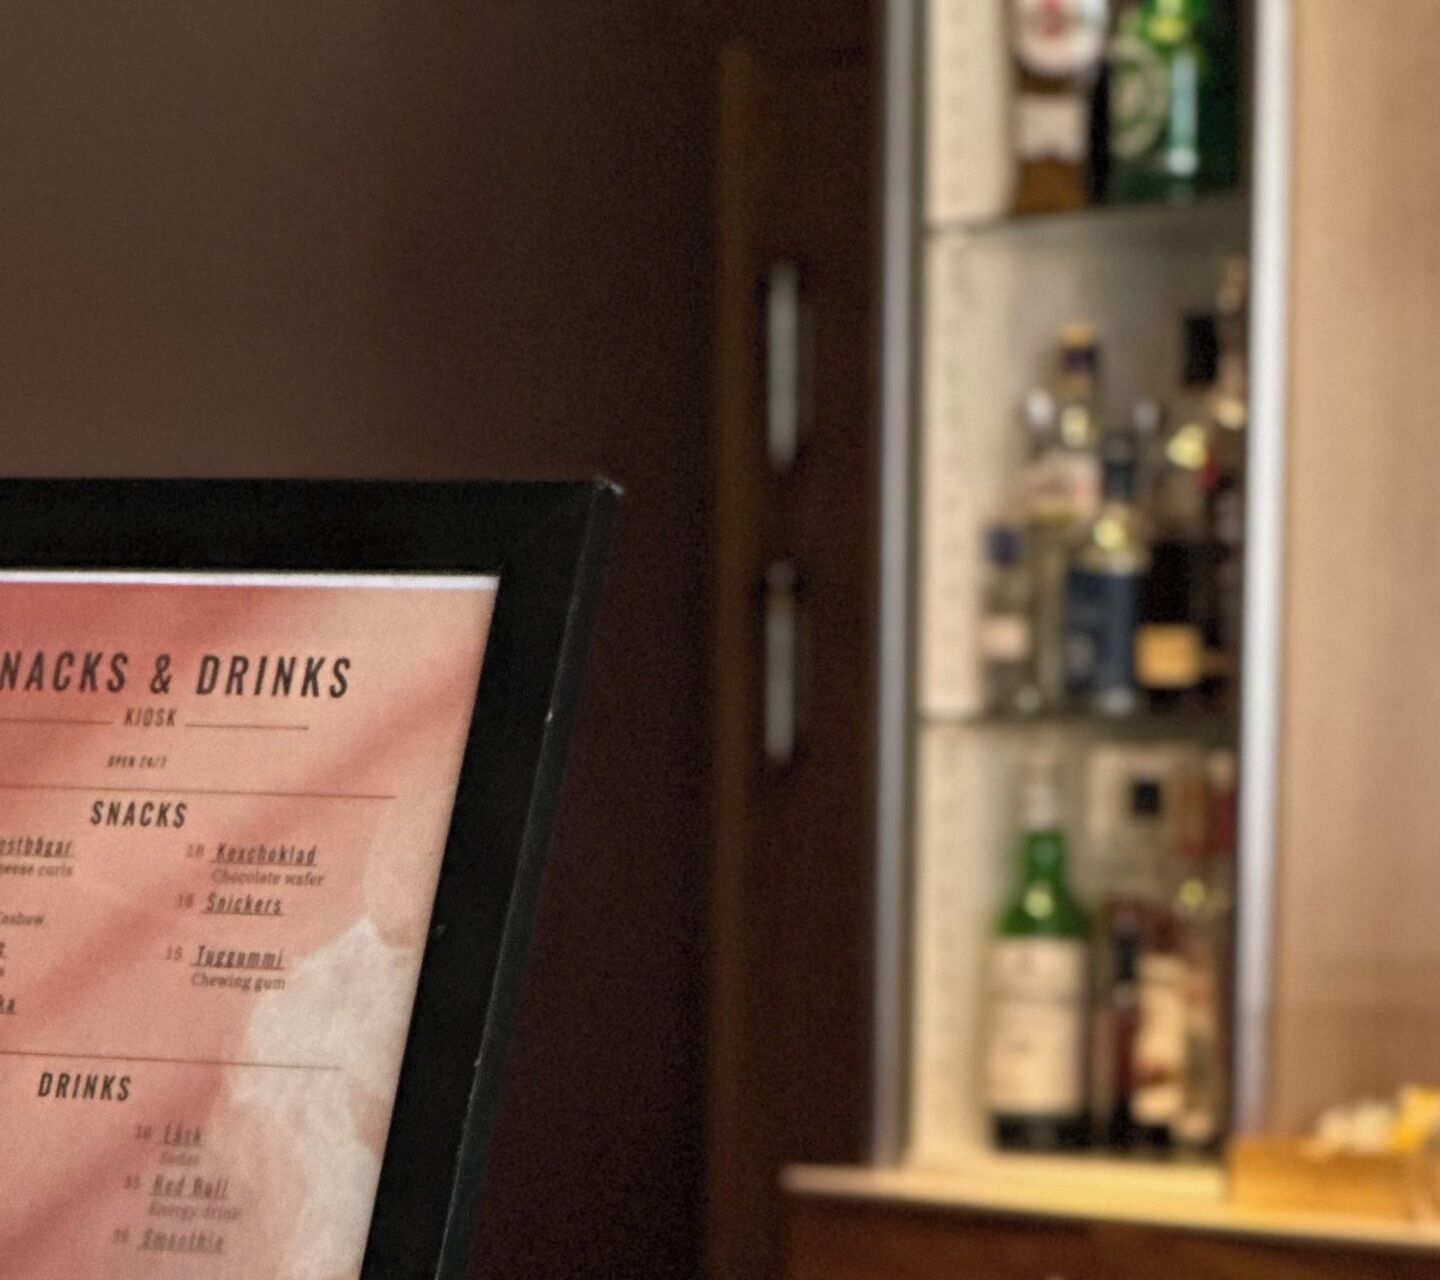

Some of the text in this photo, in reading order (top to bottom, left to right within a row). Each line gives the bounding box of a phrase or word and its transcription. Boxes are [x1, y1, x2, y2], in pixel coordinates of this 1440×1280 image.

[0, 650, 352, 700] NACKS & DRINKS
[123, 707, 179, 728] KIOSK
[90, 800, 189, 829] SNACKS
[213, 841, 317, 865] Kexchoklad
[204, 892, 282, 915] Snickers
[194, 944, 284, 969] Tuggummi
[255, 976, 286, 993] gum
[37, 1072, 132, 1102] DRINKS
